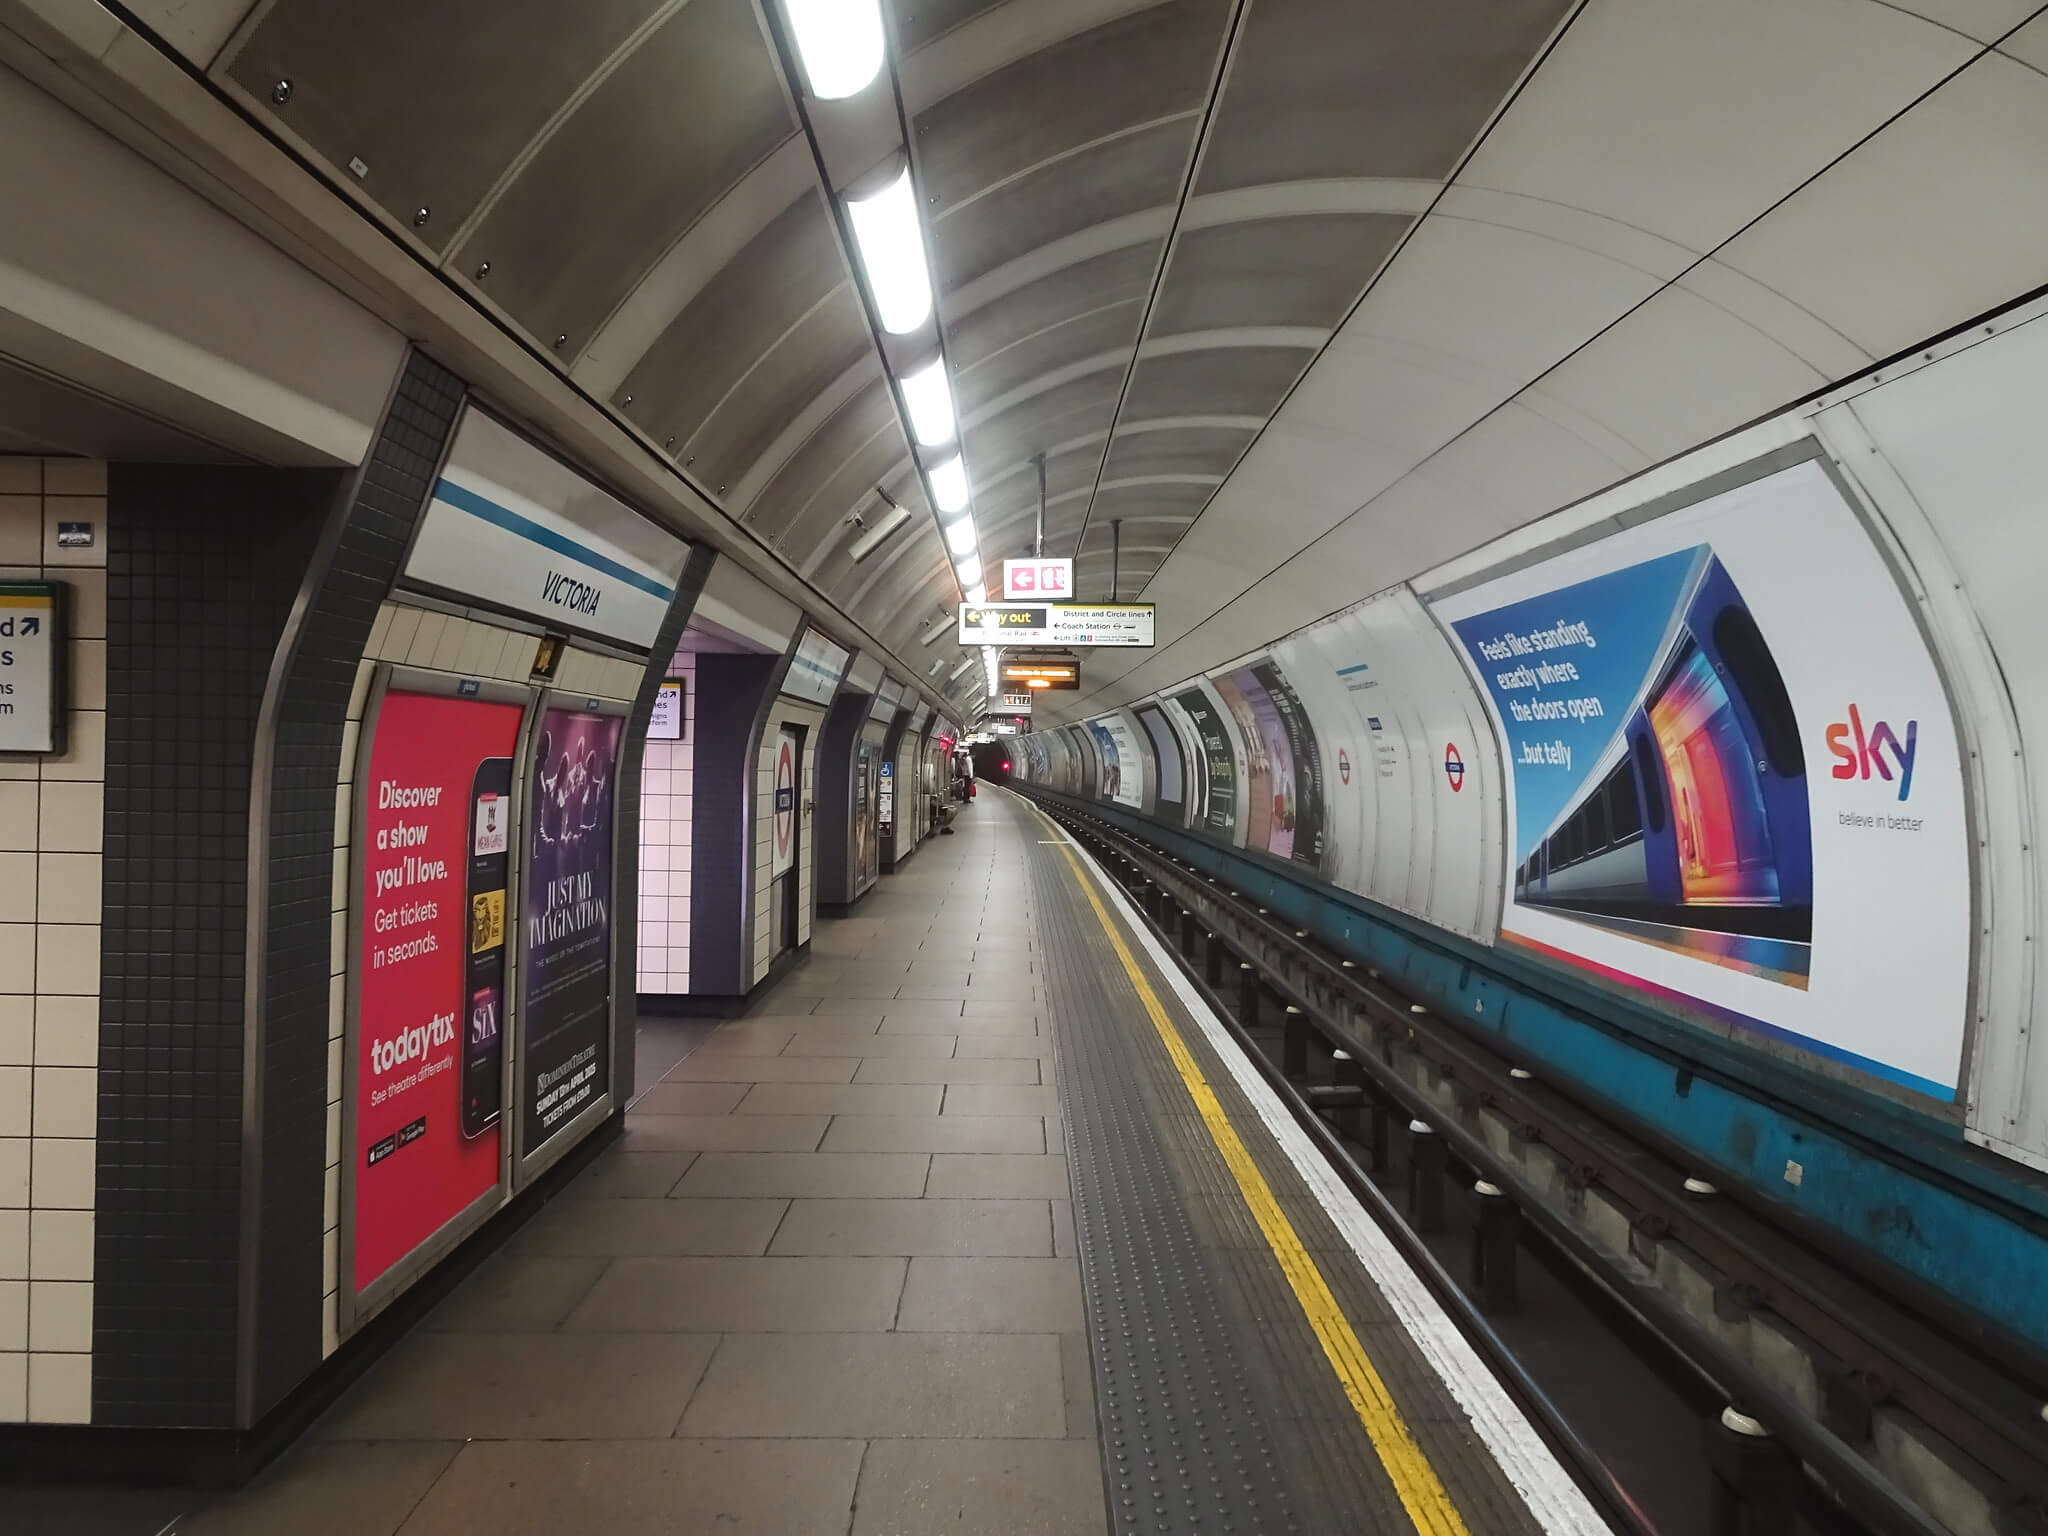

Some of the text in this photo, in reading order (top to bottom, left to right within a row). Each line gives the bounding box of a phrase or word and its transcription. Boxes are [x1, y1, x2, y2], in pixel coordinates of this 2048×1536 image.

[542, 570, 600, 616] VICTORIA
[1009, 612, 1032, 624] out
[1061, 622, 1111, 630] Coach Station
[1478, 619, 1596, 661] Feels like standing
[1497, 660, 1580, 691] exactly where
[1510, 696, 1604, 723] the doors open
[1543, 740, 1571, 771] telly
[1826, 703, 1917, 801] sky
[379, 780, 442, 809] Discover
[376, 820, 428, 850] a show
[1838, 811, 1923, 832] believe in better
[376, 855, 448, 898] you'll love.
[545, 871, 592, 917] JUST MY
[375, 900, 438, 933] Get tickets
[530, 898, 607, 949] IMAGINATION
[373, 930, 439, 969] in seconds.
[371, 1012, 455, 1075] todaytix
[371, 1090, 387, 1107] See
[388, 1074, 417, 1098] theatre
[417, 1054, 454, 1083] differently
[536, 1089, 559, 1116] SUNDAY
[570, 1070, 585, 1090] APRIL
[543, 1104, 563, 1128] TICKETS
[562, 1094, 577, 1115] FROM
